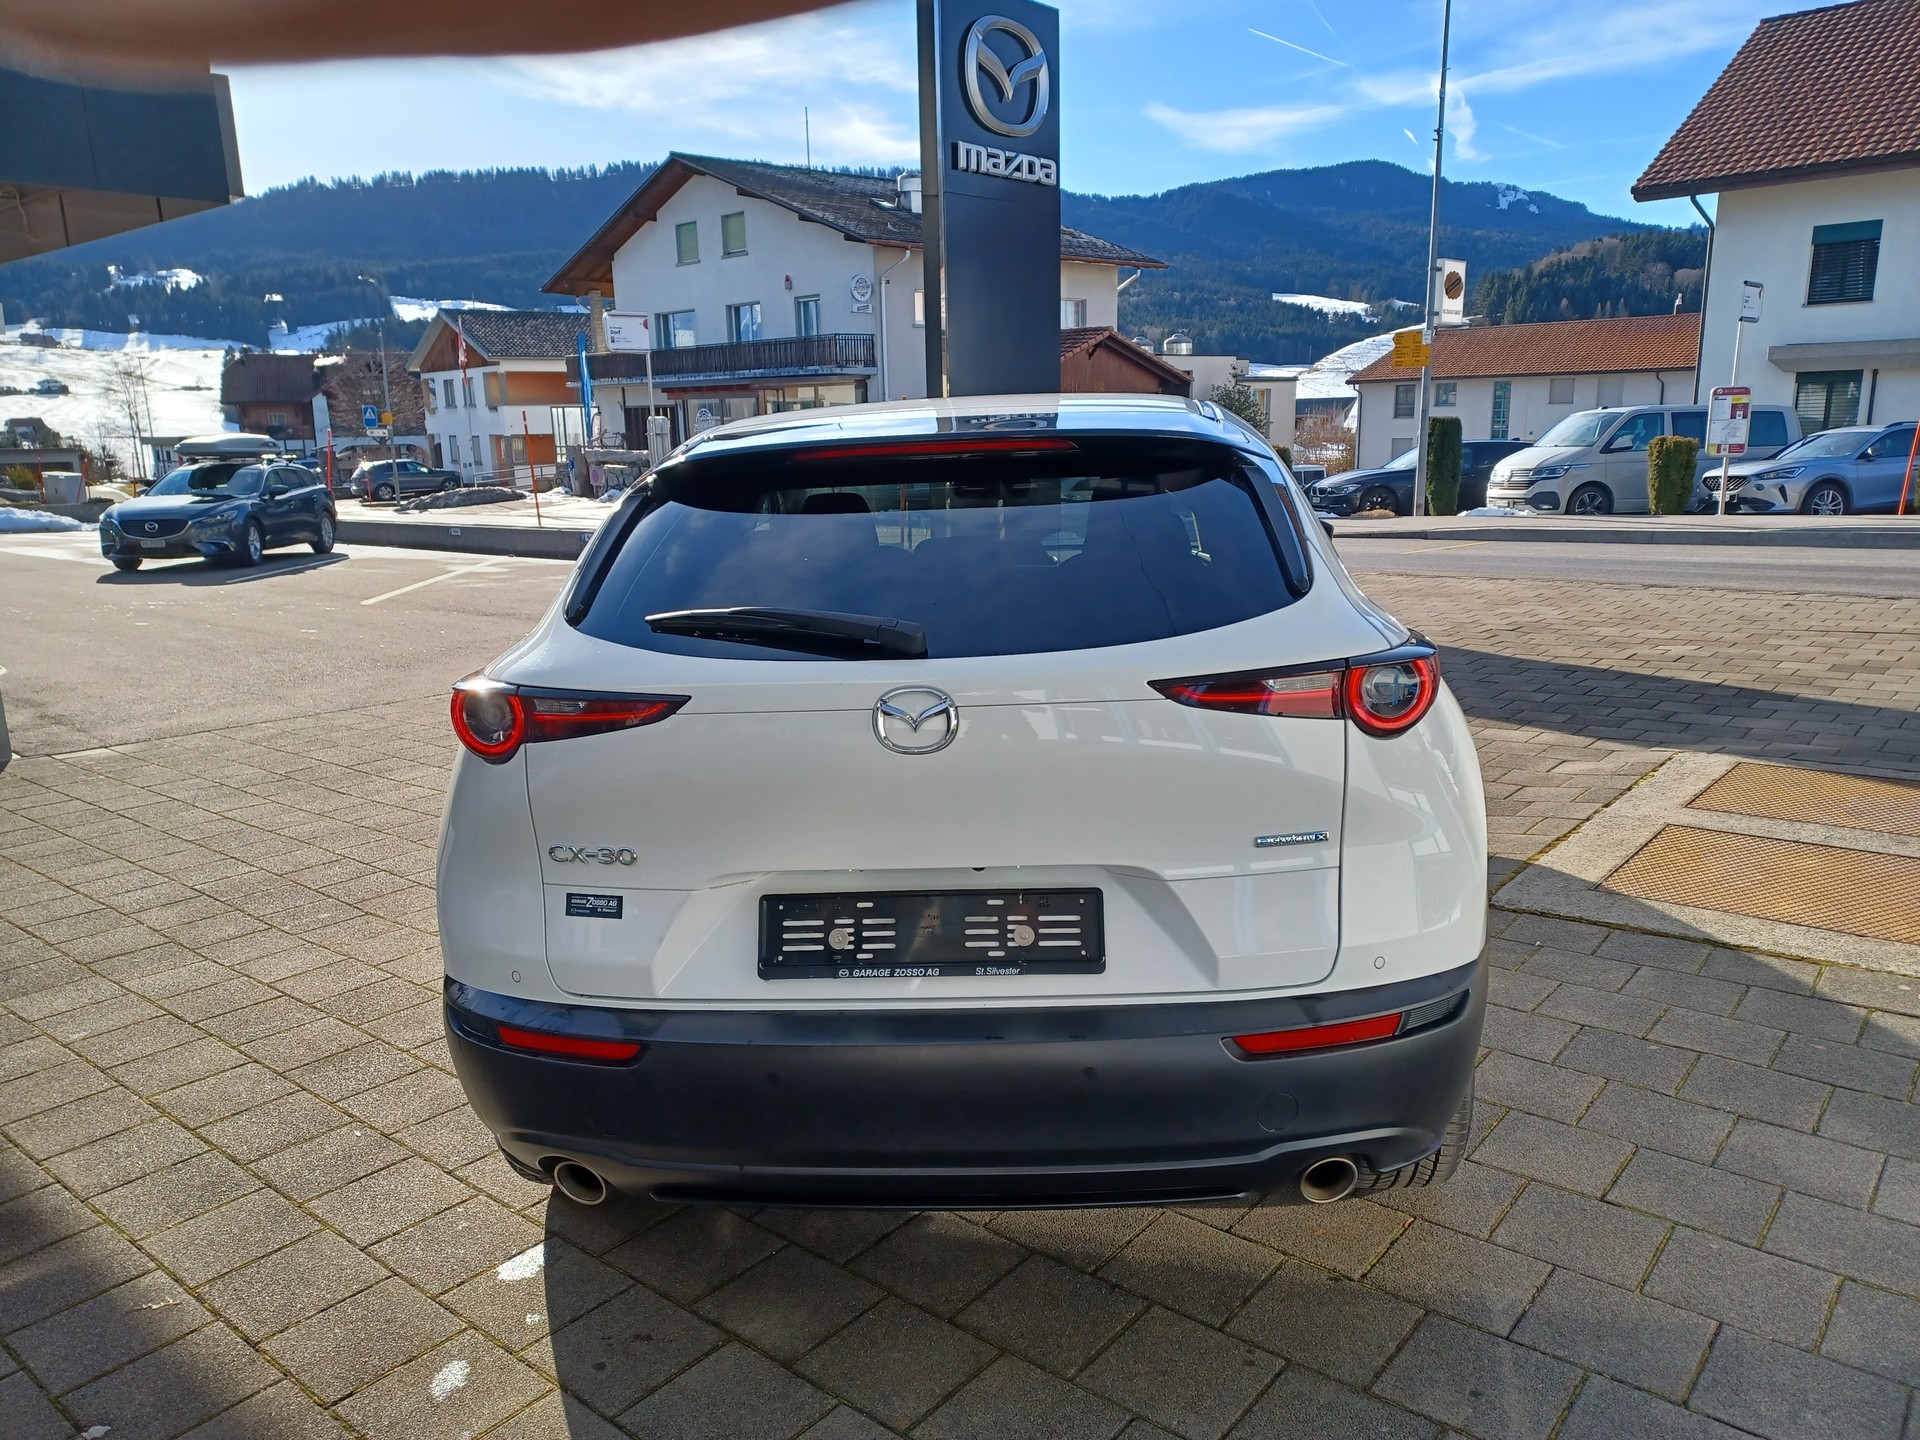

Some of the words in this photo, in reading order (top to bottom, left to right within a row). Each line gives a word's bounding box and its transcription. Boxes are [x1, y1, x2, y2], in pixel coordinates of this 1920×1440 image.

[548, 843, 638, 865] CX-30
[586, 896, 608, 908] ZOSSO
[852, 968, 891, 977] GARAGE
[893, 968, 925, 977] ZOSSO
[926, 968, 940, 976] AG
